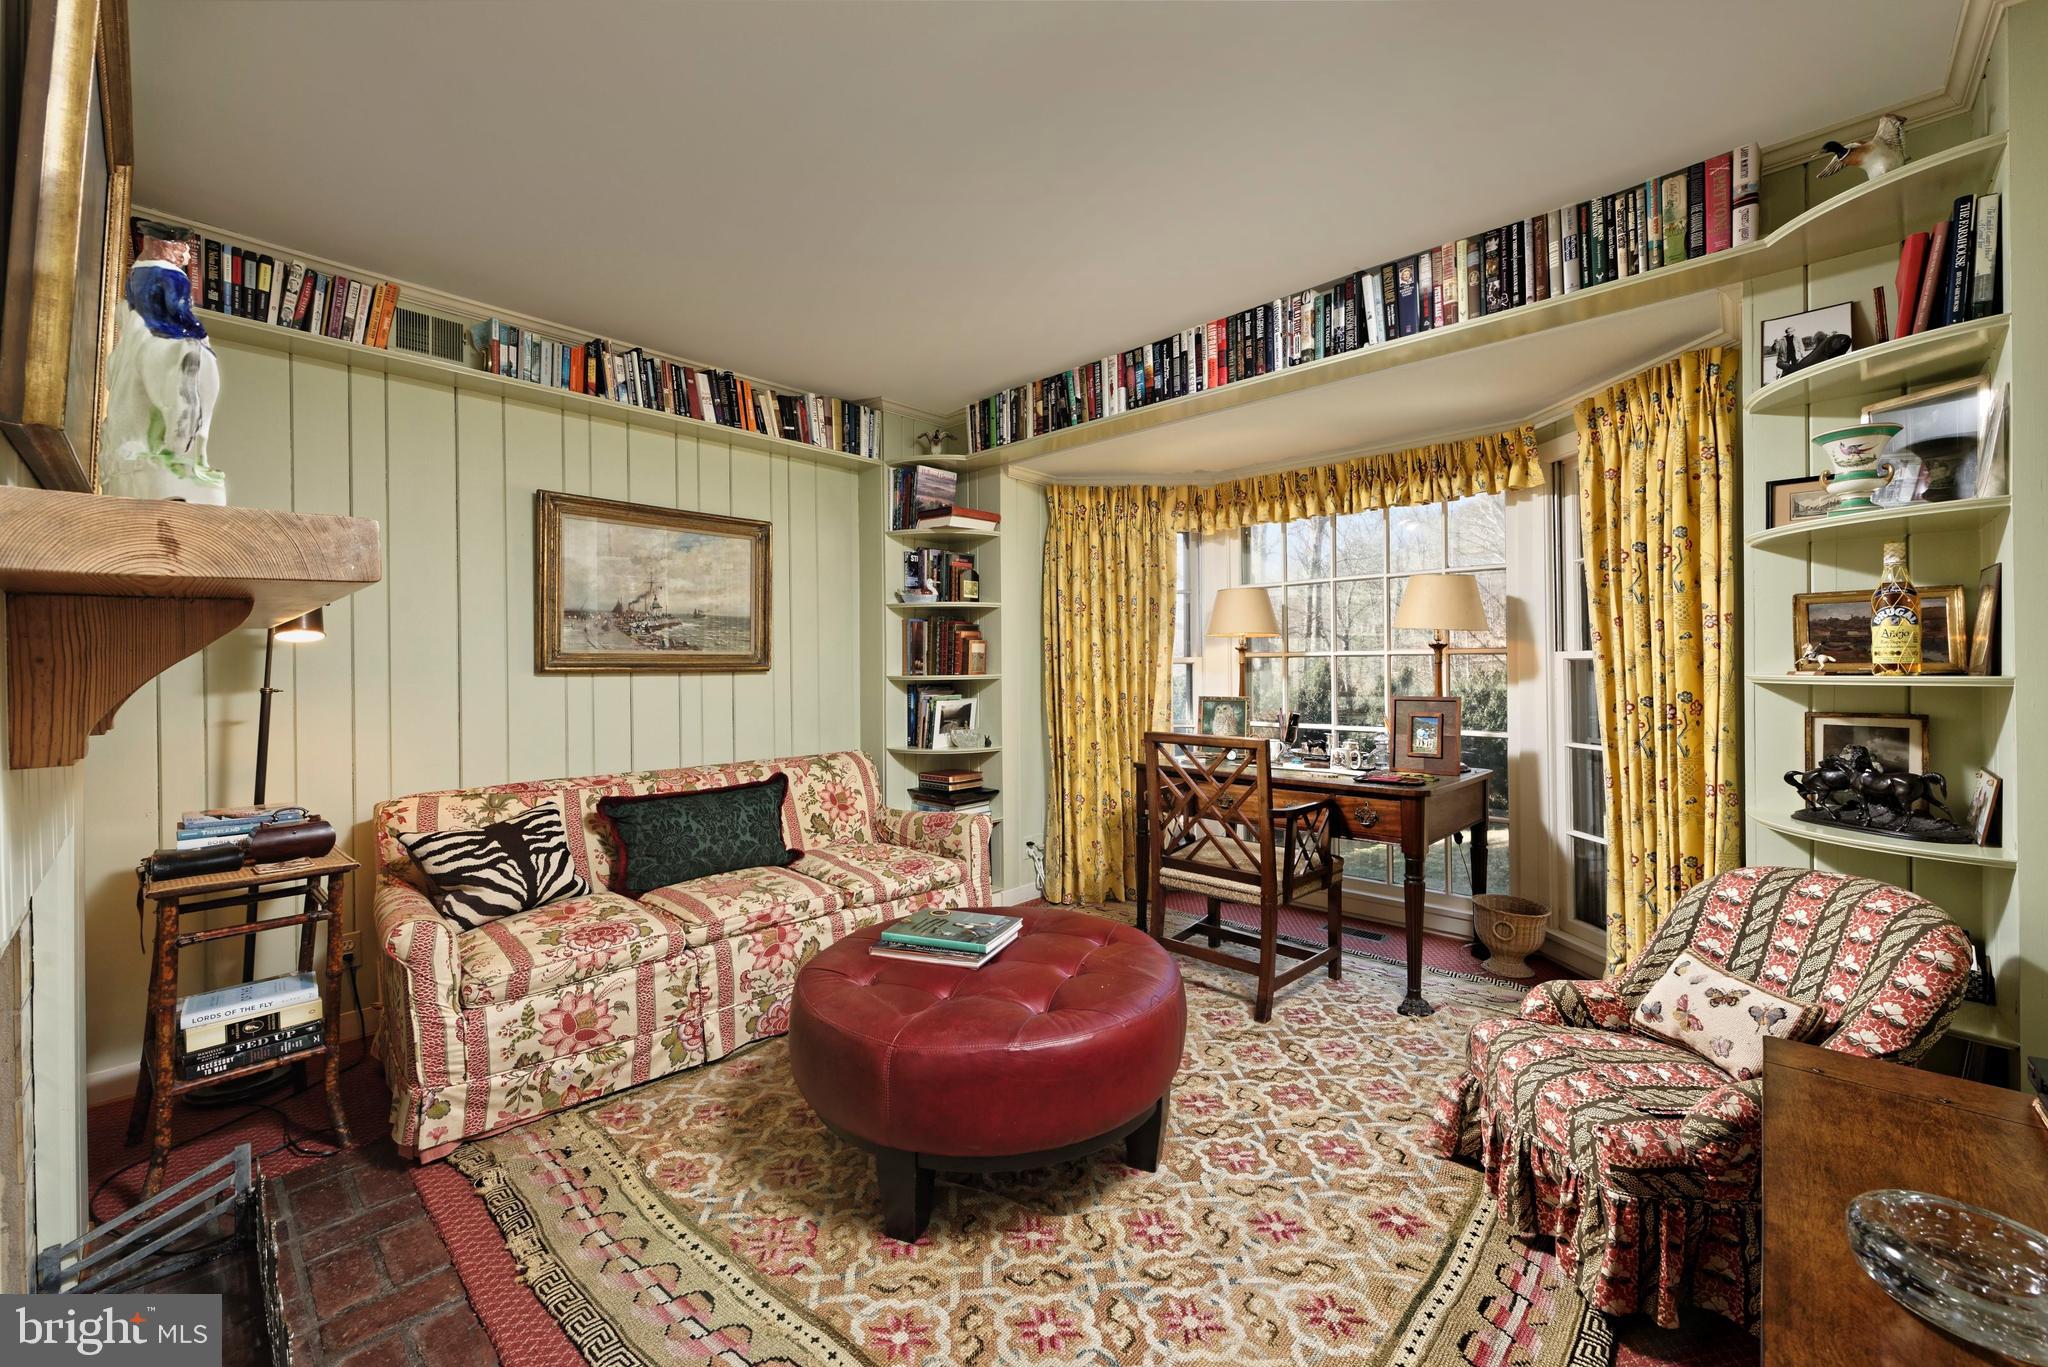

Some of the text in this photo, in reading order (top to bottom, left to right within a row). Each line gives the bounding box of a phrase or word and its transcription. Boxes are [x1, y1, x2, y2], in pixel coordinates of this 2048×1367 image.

[1955, 202, 1971, 268] THE FARMHOUSE
[1873, 607, 1917, 625] BRUGAL
[192, 1001, 274, 1024] LORDS OF THE FLY
[235, 1037, 269, 1052] FED
[274, 1030, 296, 1041] UP
[196, 1056, 234, 1072] ACCESSORY
[213, 1064, 227, 1073] WAR
